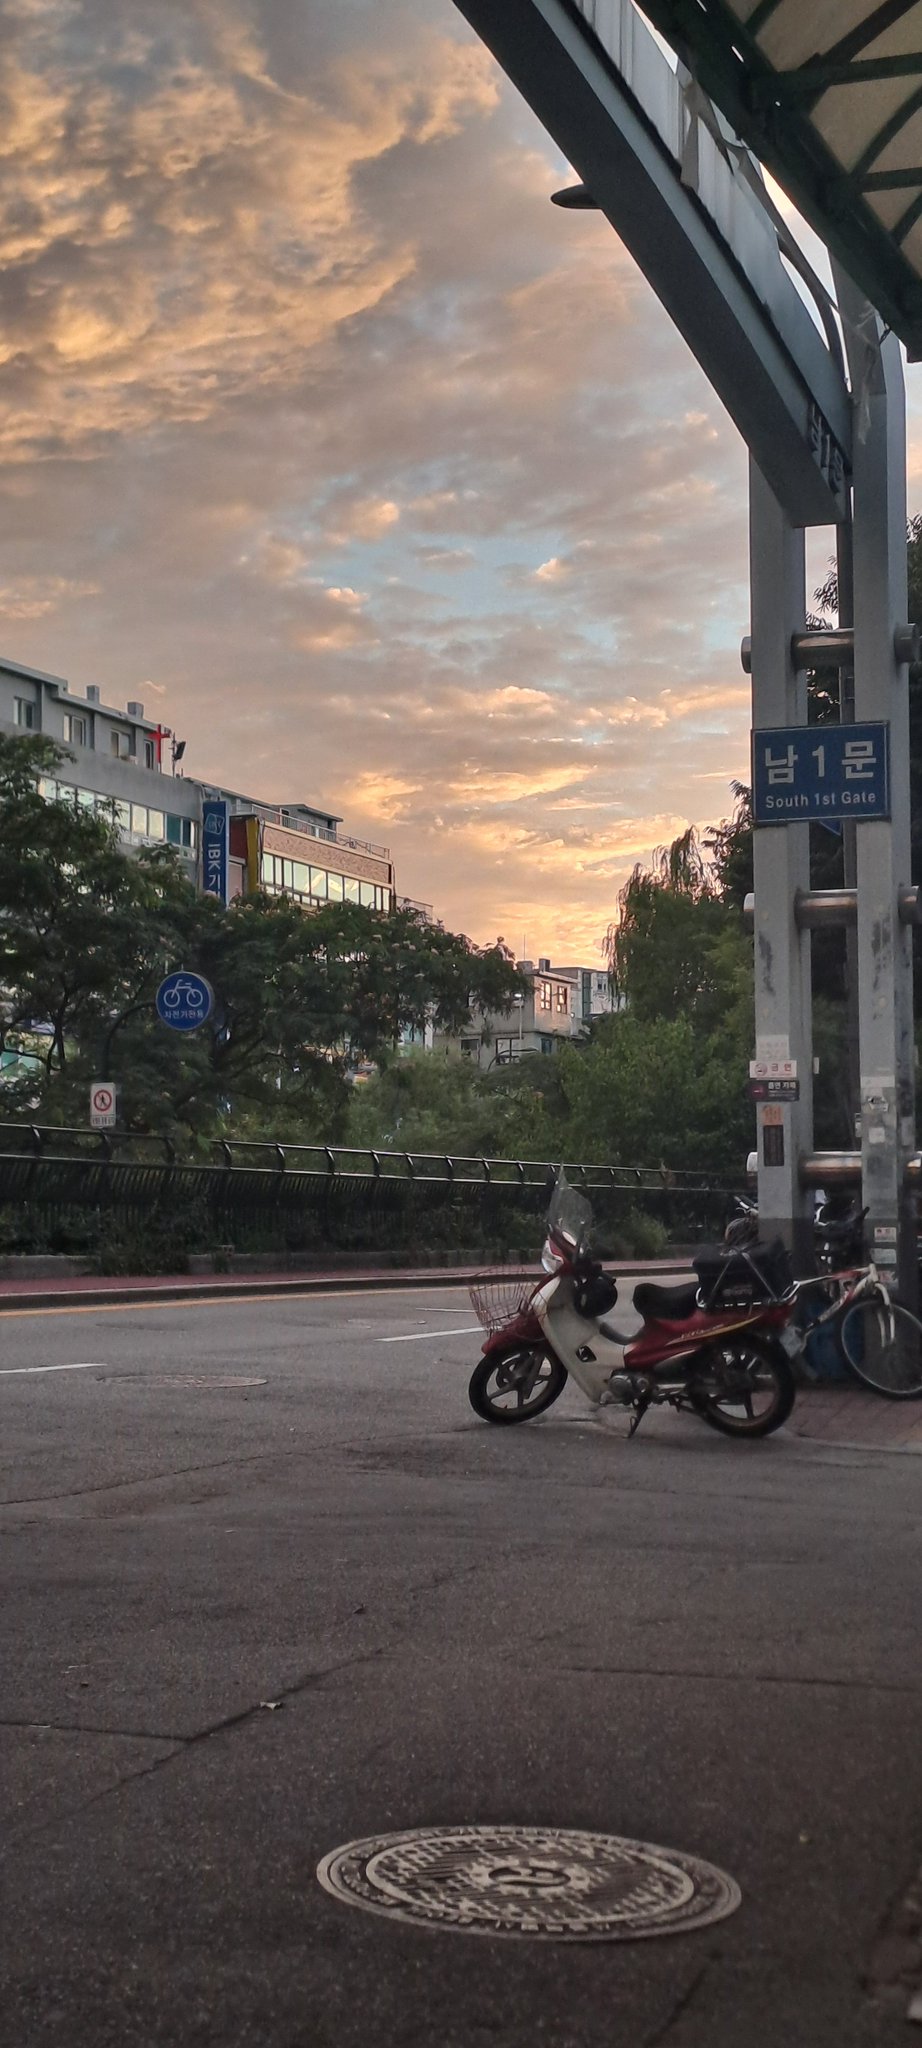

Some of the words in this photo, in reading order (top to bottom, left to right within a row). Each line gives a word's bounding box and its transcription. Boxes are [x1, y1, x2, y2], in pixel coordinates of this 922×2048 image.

[765, 793, 809, 810] South
[814, 792, 836, 806] 1st
[841, 790, 876, 805] Gate
